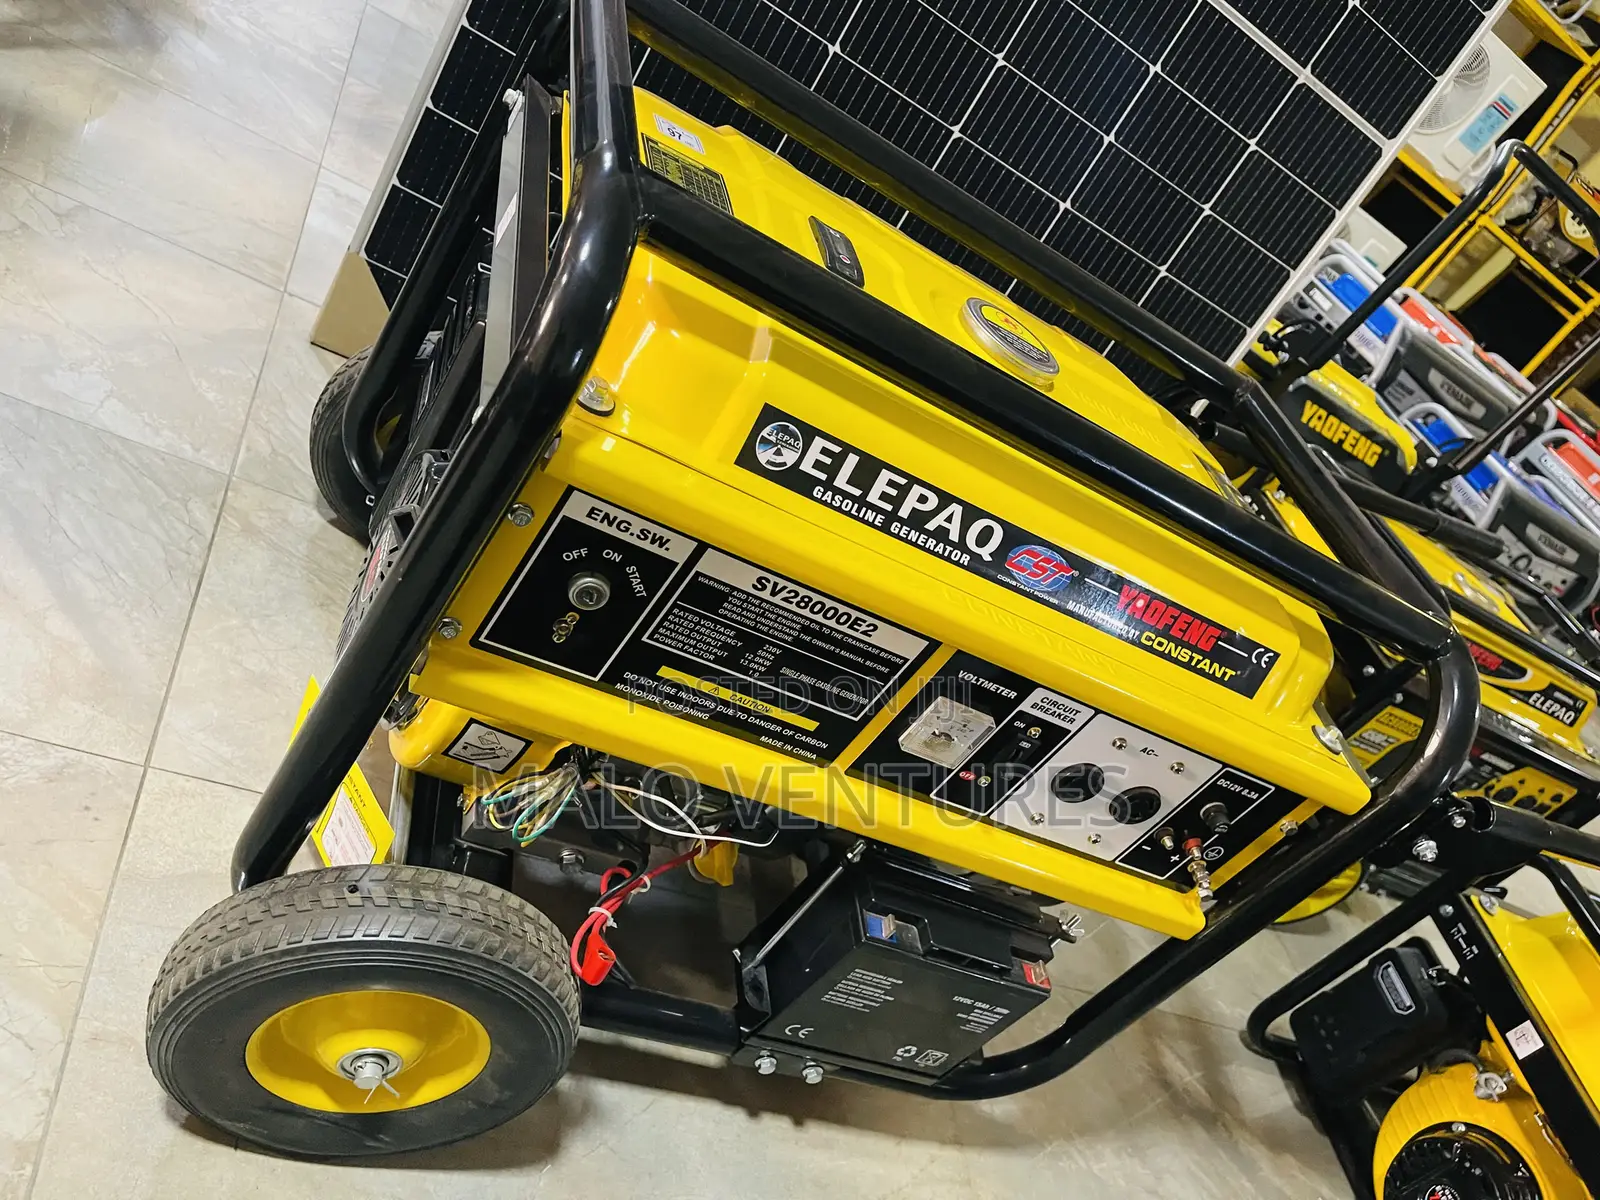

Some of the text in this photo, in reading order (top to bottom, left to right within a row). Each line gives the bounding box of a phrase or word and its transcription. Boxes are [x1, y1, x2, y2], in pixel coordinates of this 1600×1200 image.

[766, 428, 801, 449] ELEPAQ
[1300, 399, 1383, 468] YAOFENG
[799, 435, 1004, 562] ELEPAQ
[585, 506, 672, 552] ENG.SW.
[812, 485, 972, 566] GASOLINE GENERATOR
[562, 548, 647, 597] OFF ON START
[1005, 549, 1078, 585] CST
[727, 596, 742, 606] YOU
[742, 602, 764, 615] START
[763, 610, 778, 620] THE
[751, 575, 879, 638] SV28000E2
[996, 574, 1060, 605] CONSTANT POWER
[667, 614, 775, 661] RATED FREQUENCY 50Hz
[672, 608, 783, 655] RATED VOLTAGE 230V
[697, 575, 905, 665] WARNING: ADD THE RECOMMENDED OIL TO THE CRANKCASE BEFORE
[718, 608, 756, 627] OPERATING
[755, 622, 769, 633] THE
[1115, 584, 1222, 652] YAOFENG
[653, 633, 760, 678] POWER FACTOR 1.0
[657, 627, 767, 673] MAXIMUM OUTPUT 13.0KW
[663, 620, 773, 667] RATED OUTPUT 12.0KW
[722, 602, 890, 674] READ AND UNDERSTAND THE OWNER'S MANUAL BEFORE
[1140, 630, 1237, 682] CONSTANT
[1251, 648, 1274, 669] CE
[614, 682, 710, 721] MONOXIDE POISONING
[729, 693, 772, 714] CAUTION
[780, 666, 869, 706] SINGLE PHASE GASOLINE GENERATOR
[958, 670, 1018, 700] VOLTMETER
[623, 671, 829, 750] DO NOT USE INDOORS DUE TO DANGER OF CARBON
[1013, 720, 1026, 729] ON
[1030, 702, 1076, 726] BREAKER
[1040, 696, 1082, 717] CIRCUIT
[1527, 692, 1576, 725] ELEPAQ
[759, 735, 817, 760] MADE IN CHINA
[959, 771, 976, 780] OFF
[1216, 778, 1244, 792] DC12V
[784, 1024, 814, 1038] CE
